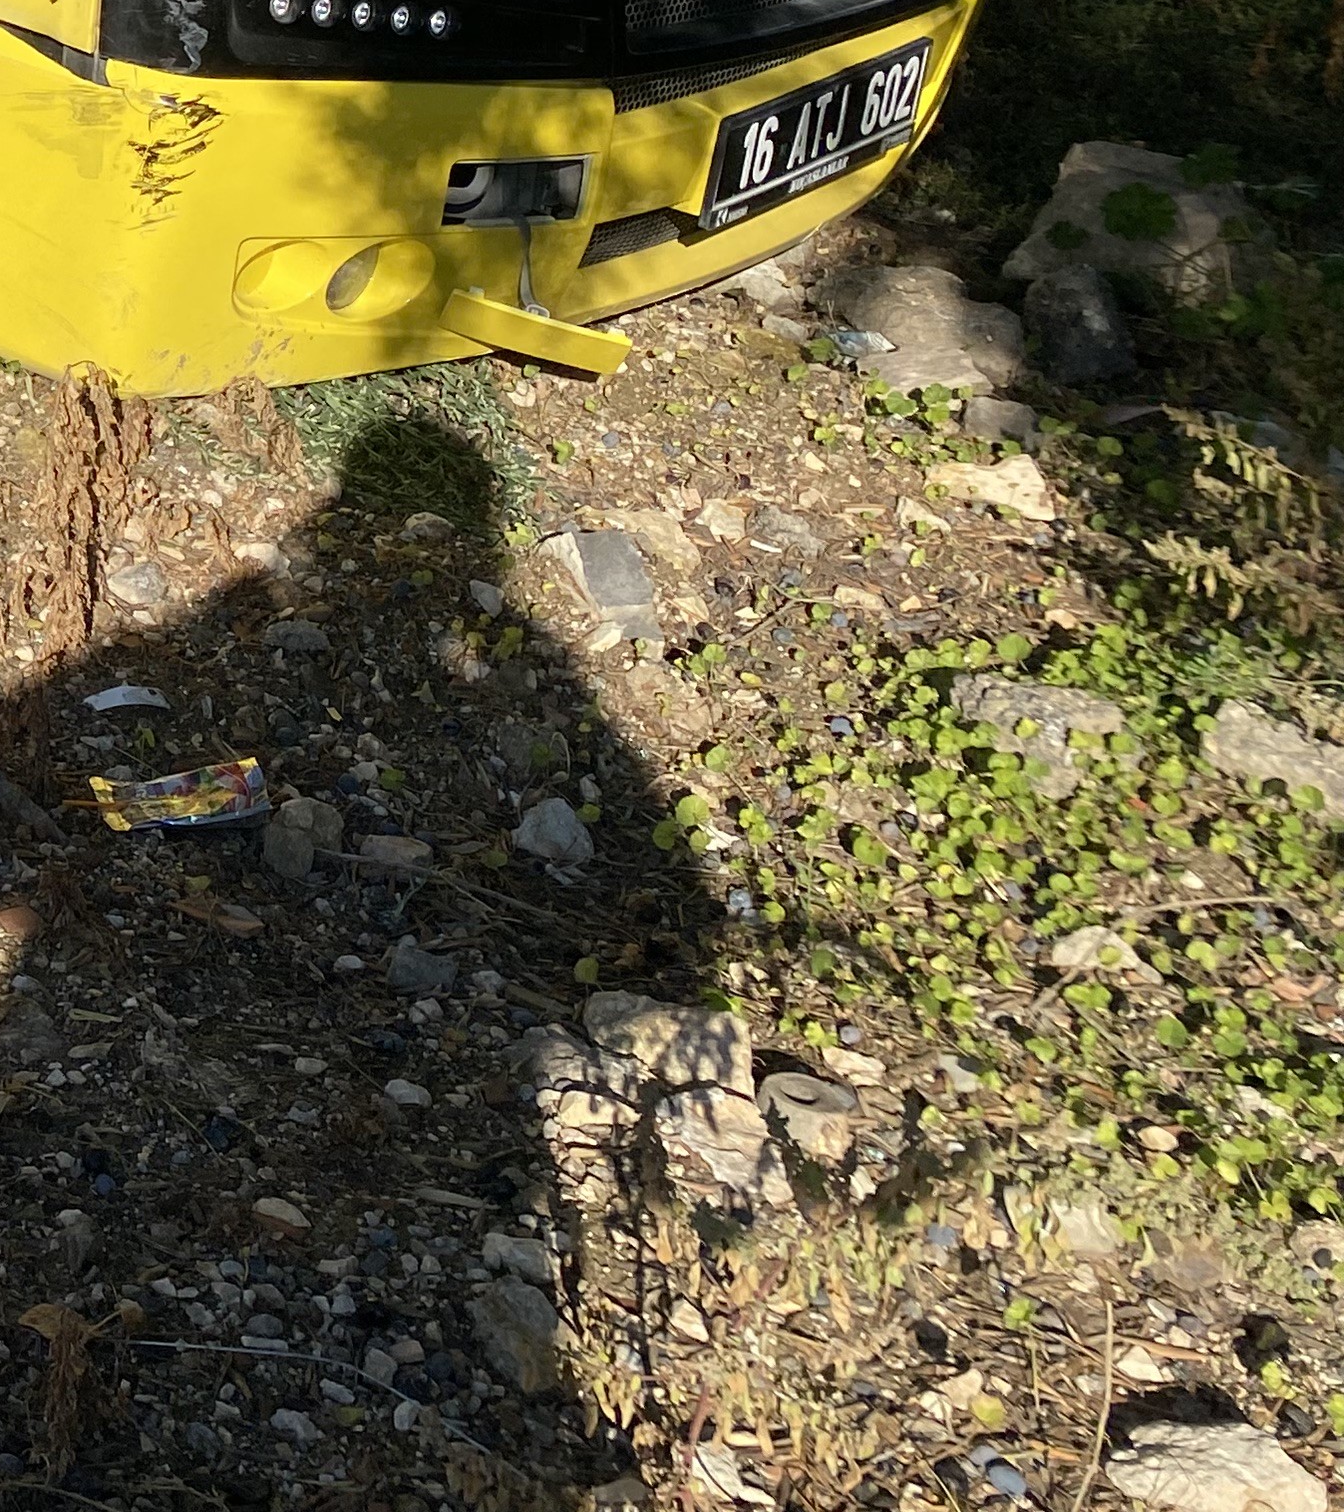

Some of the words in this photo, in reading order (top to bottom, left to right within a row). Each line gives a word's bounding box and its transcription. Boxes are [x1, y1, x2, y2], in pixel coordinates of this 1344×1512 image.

[739, 115, 780, 190] 16
[786, 83, 851, 171] ATJ
[860, 55, 920, 136] 602
